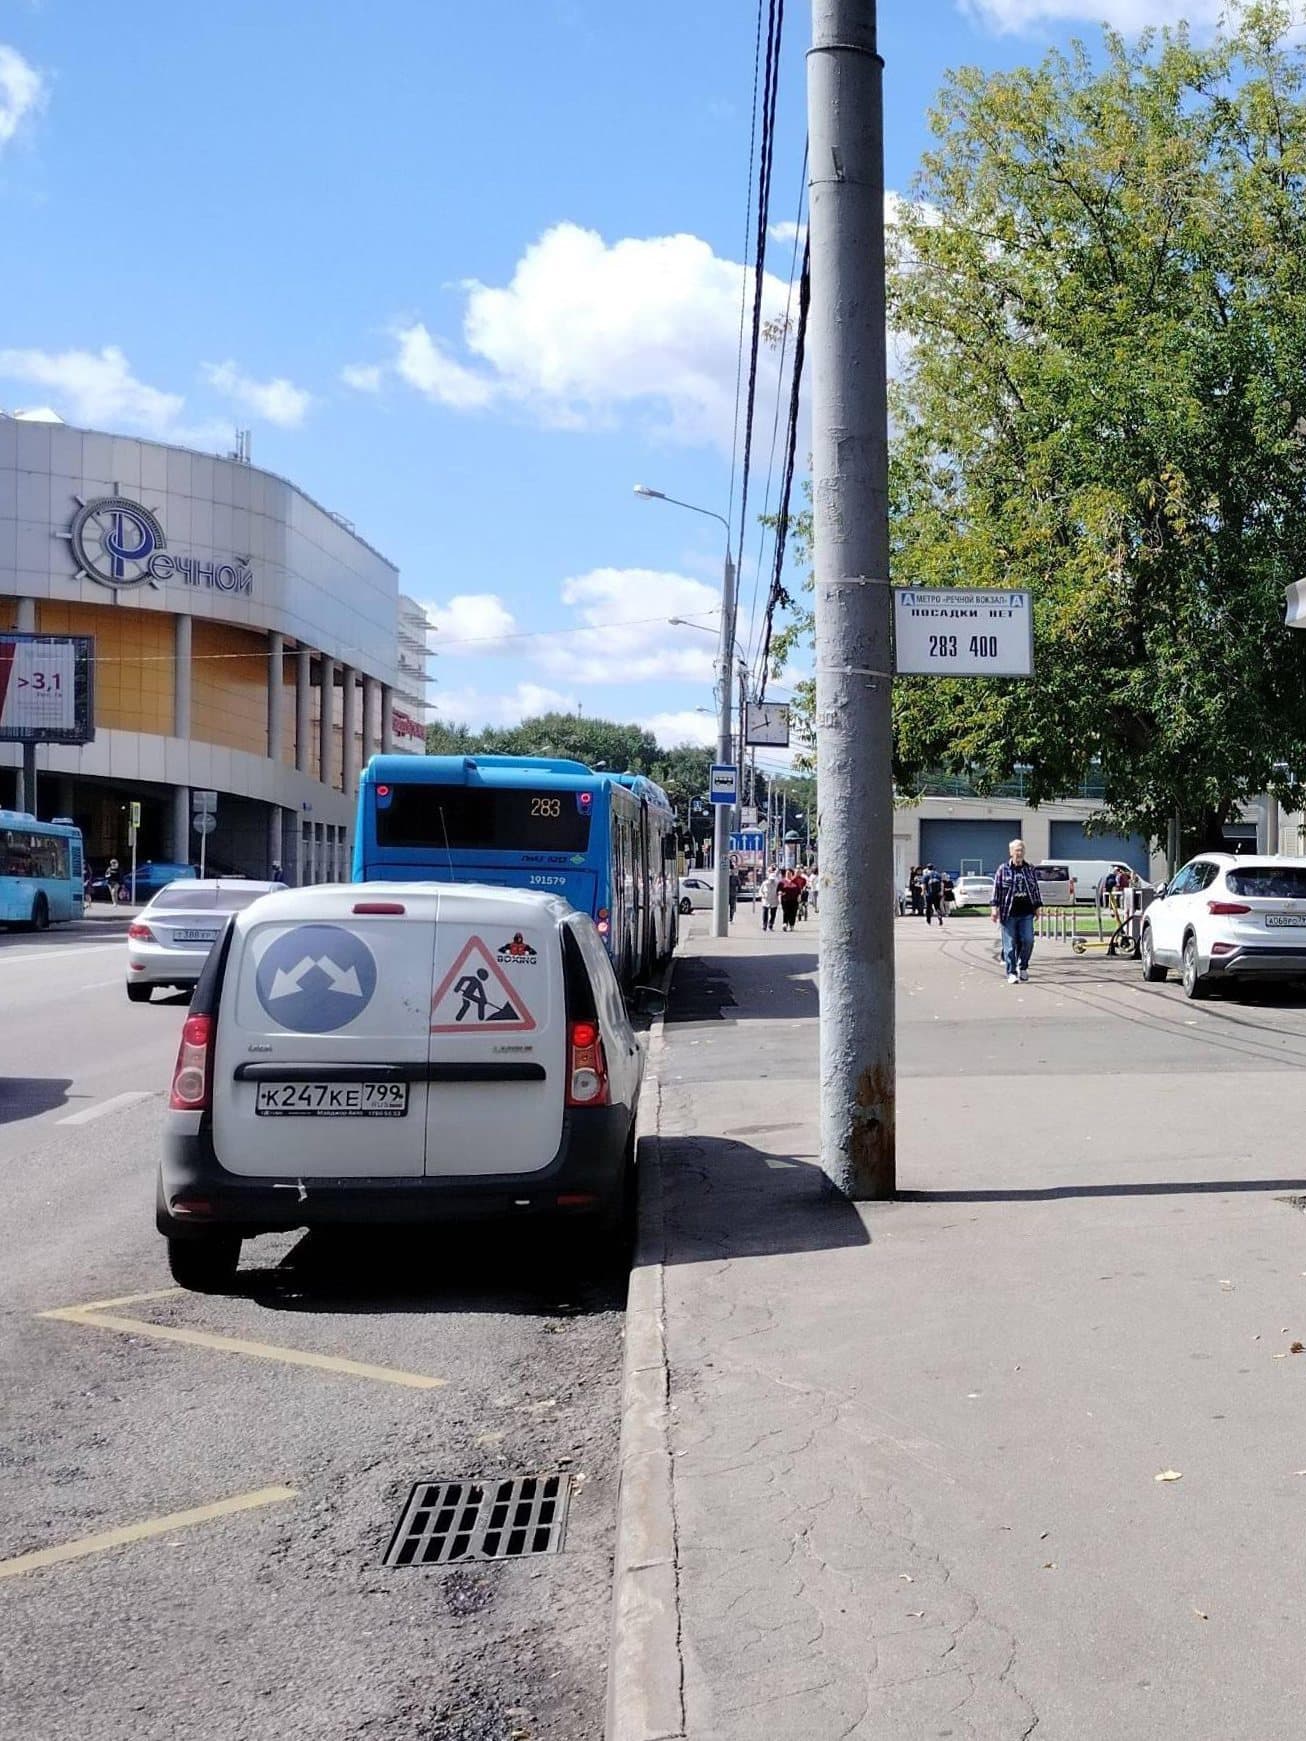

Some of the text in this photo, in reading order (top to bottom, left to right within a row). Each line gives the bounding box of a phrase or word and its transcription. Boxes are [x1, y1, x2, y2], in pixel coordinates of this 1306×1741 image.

[102, 507, 254, 595] Речной
[929, 635, 998, 657] 283 400
[531, 797, 561, 817] 283
[528, 874, 567, 886] 191579
[497, 955, 537, 965] BOXING
[365, 1084, 401, 1101] 799
